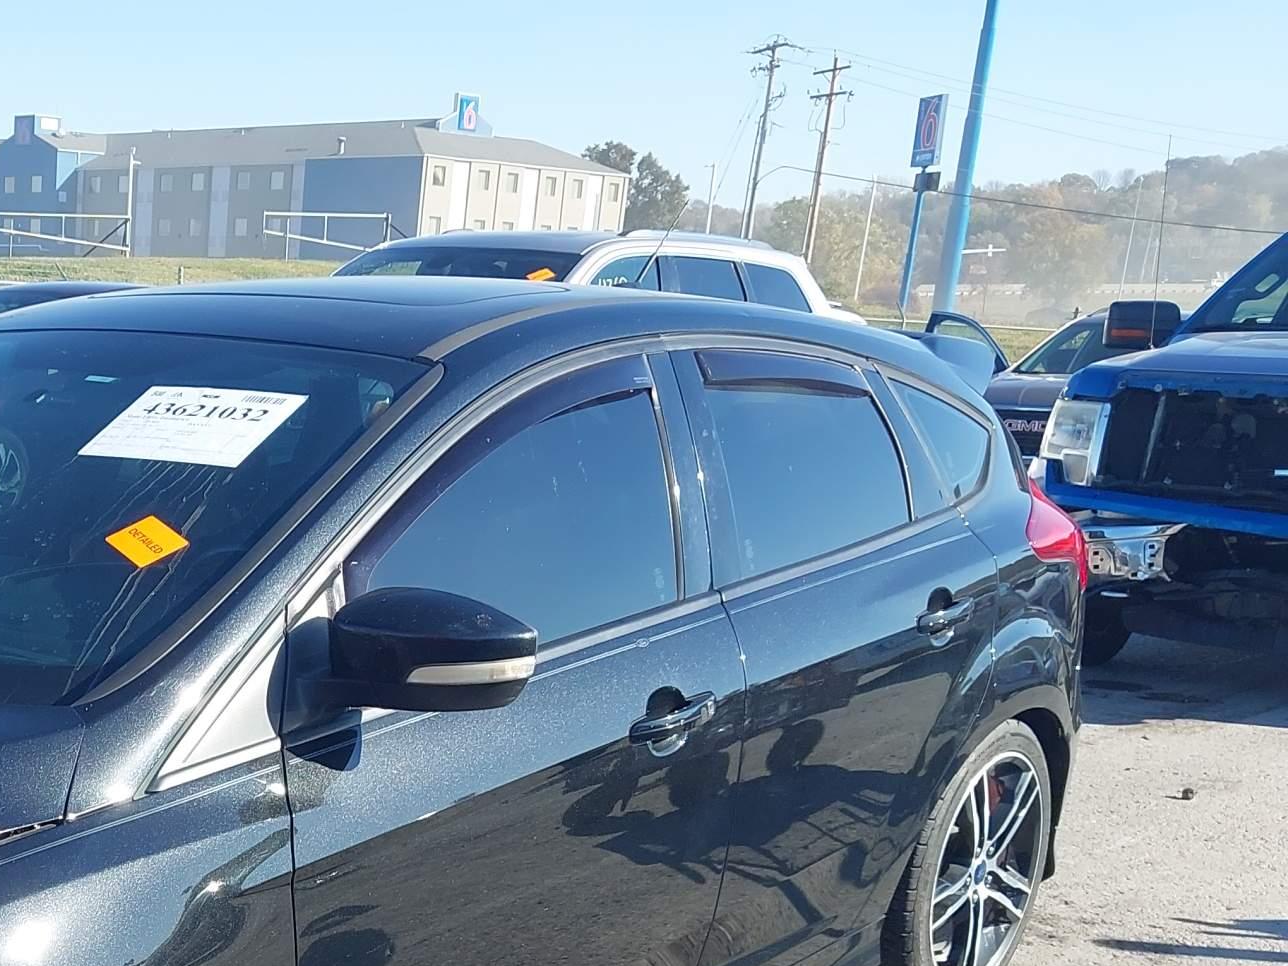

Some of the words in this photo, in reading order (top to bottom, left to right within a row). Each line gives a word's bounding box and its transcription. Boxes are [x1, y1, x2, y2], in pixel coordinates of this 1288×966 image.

[464, 101, 477, 129] 6
[920, 97, 938, 150] 6
[143, 401, 269, 422] 43621032
[128, 528, 164, 555] DETAILED
